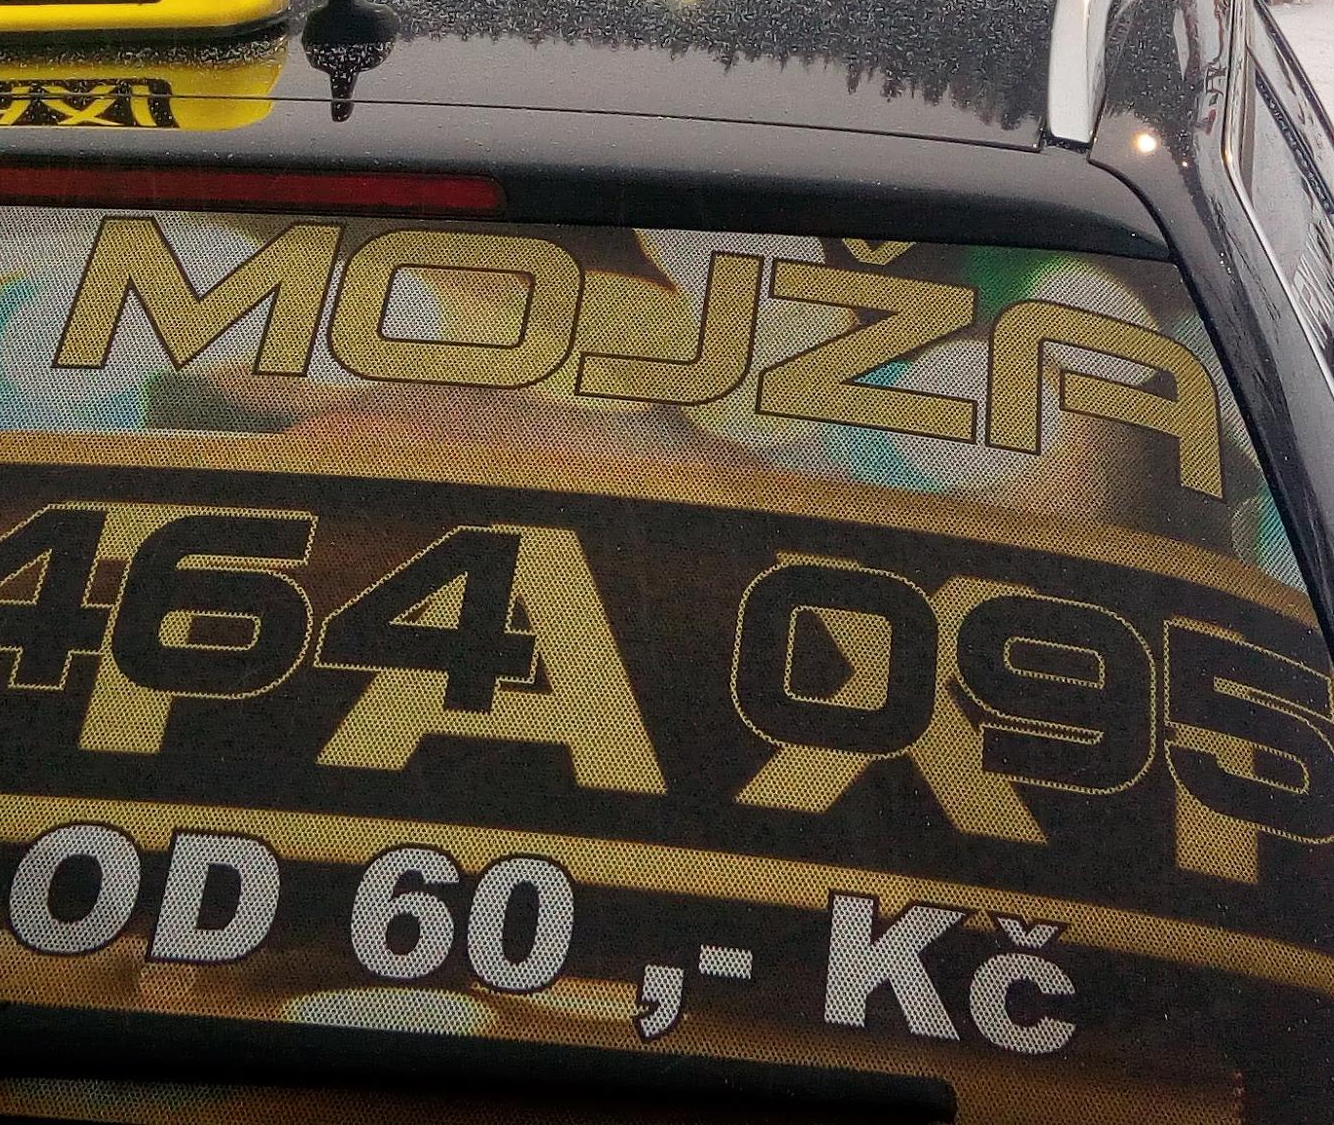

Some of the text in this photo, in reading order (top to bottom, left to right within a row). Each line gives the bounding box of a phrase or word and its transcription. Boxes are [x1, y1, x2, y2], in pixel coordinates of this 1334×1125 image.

[51, 216, 1227, 502] MOJŽA
[6, 822, 281, 966] OD
[347, 843, 576, 995] 60
[822, 892, 1078, 1057] Kč
